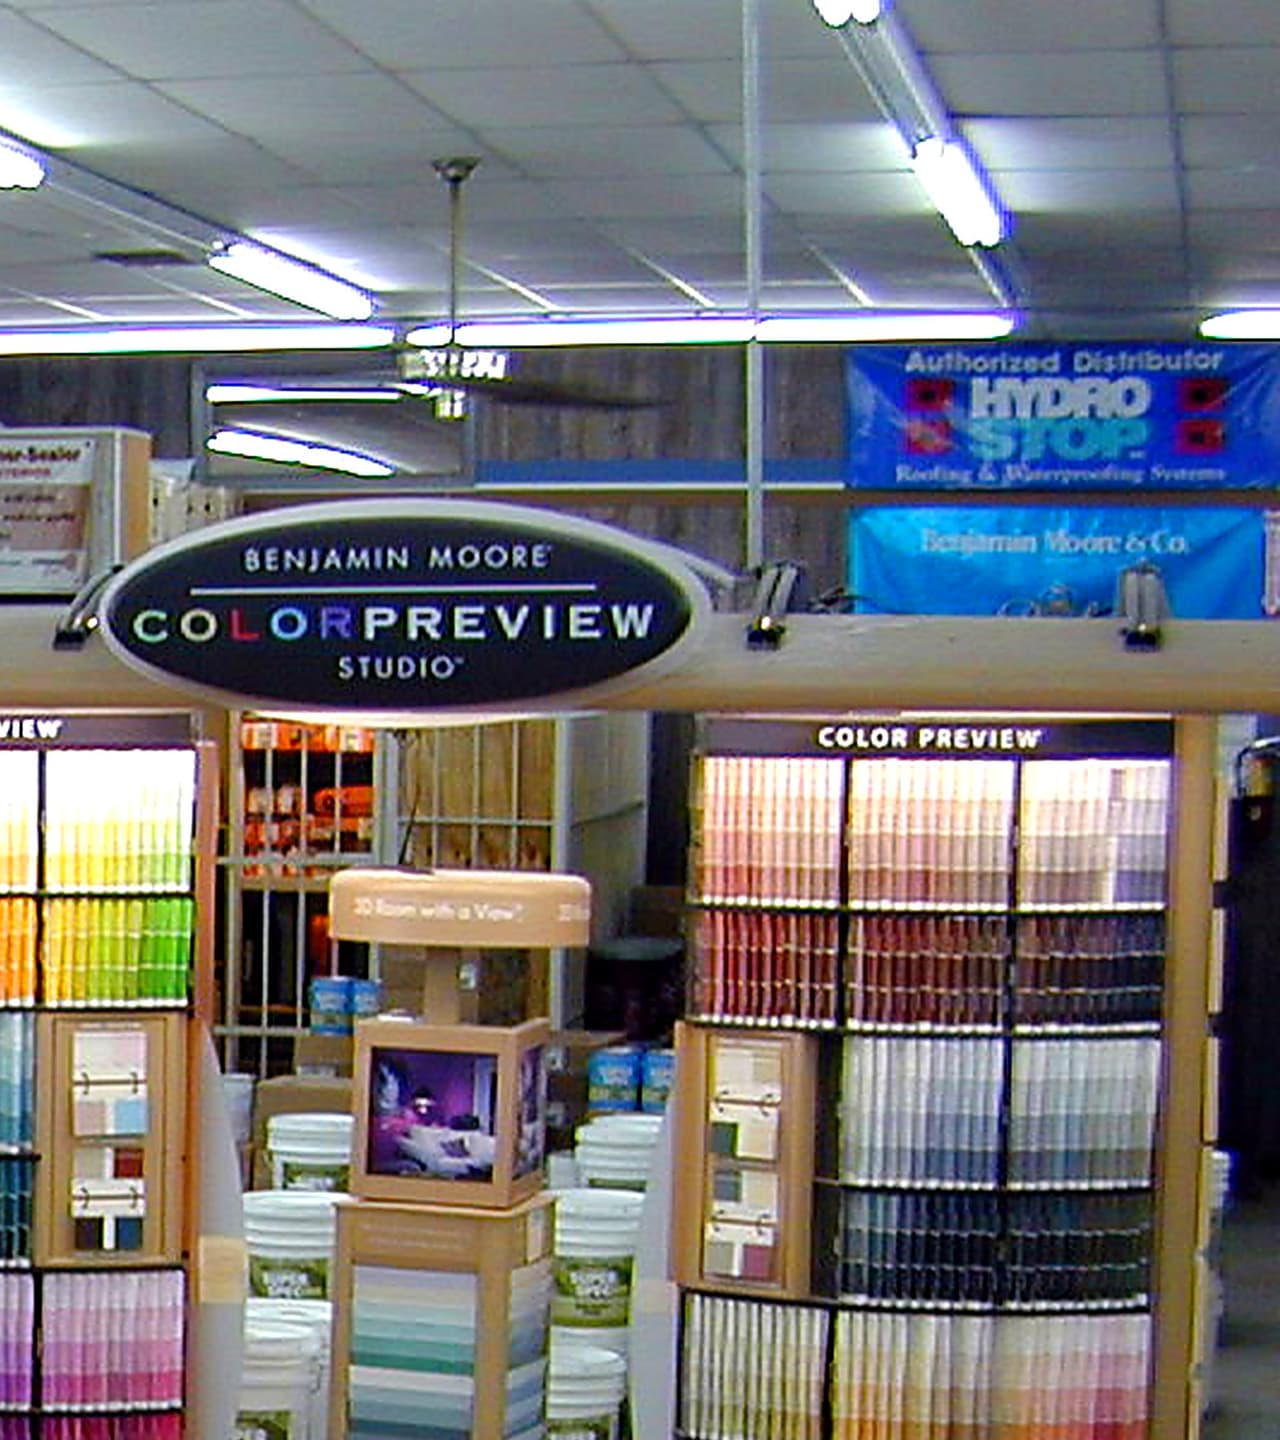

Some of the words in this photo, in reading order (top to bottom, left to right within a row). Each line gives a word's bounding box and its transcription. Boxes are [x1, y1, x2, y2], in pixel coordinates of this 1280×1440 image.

[905, 351, 1060, 373] Authorized
[1073, 350, 1224, 372] Distributor
[971, 376, 1151, 419] HYDRO
[970, 418, 1149, 461] STOP
[921, 527, 1037, 554] Benjamin
[244, 547, 410, 574] BENJAMIN
[428, 545, 548, 570] MOORE
[132, 603, 652, 643] COLORPREVIEW
[338, 655, 456, 680] STUDIO
[818, 727, 907, 749] COLOR
[919, 728, 1043, 750] PREVIEW
